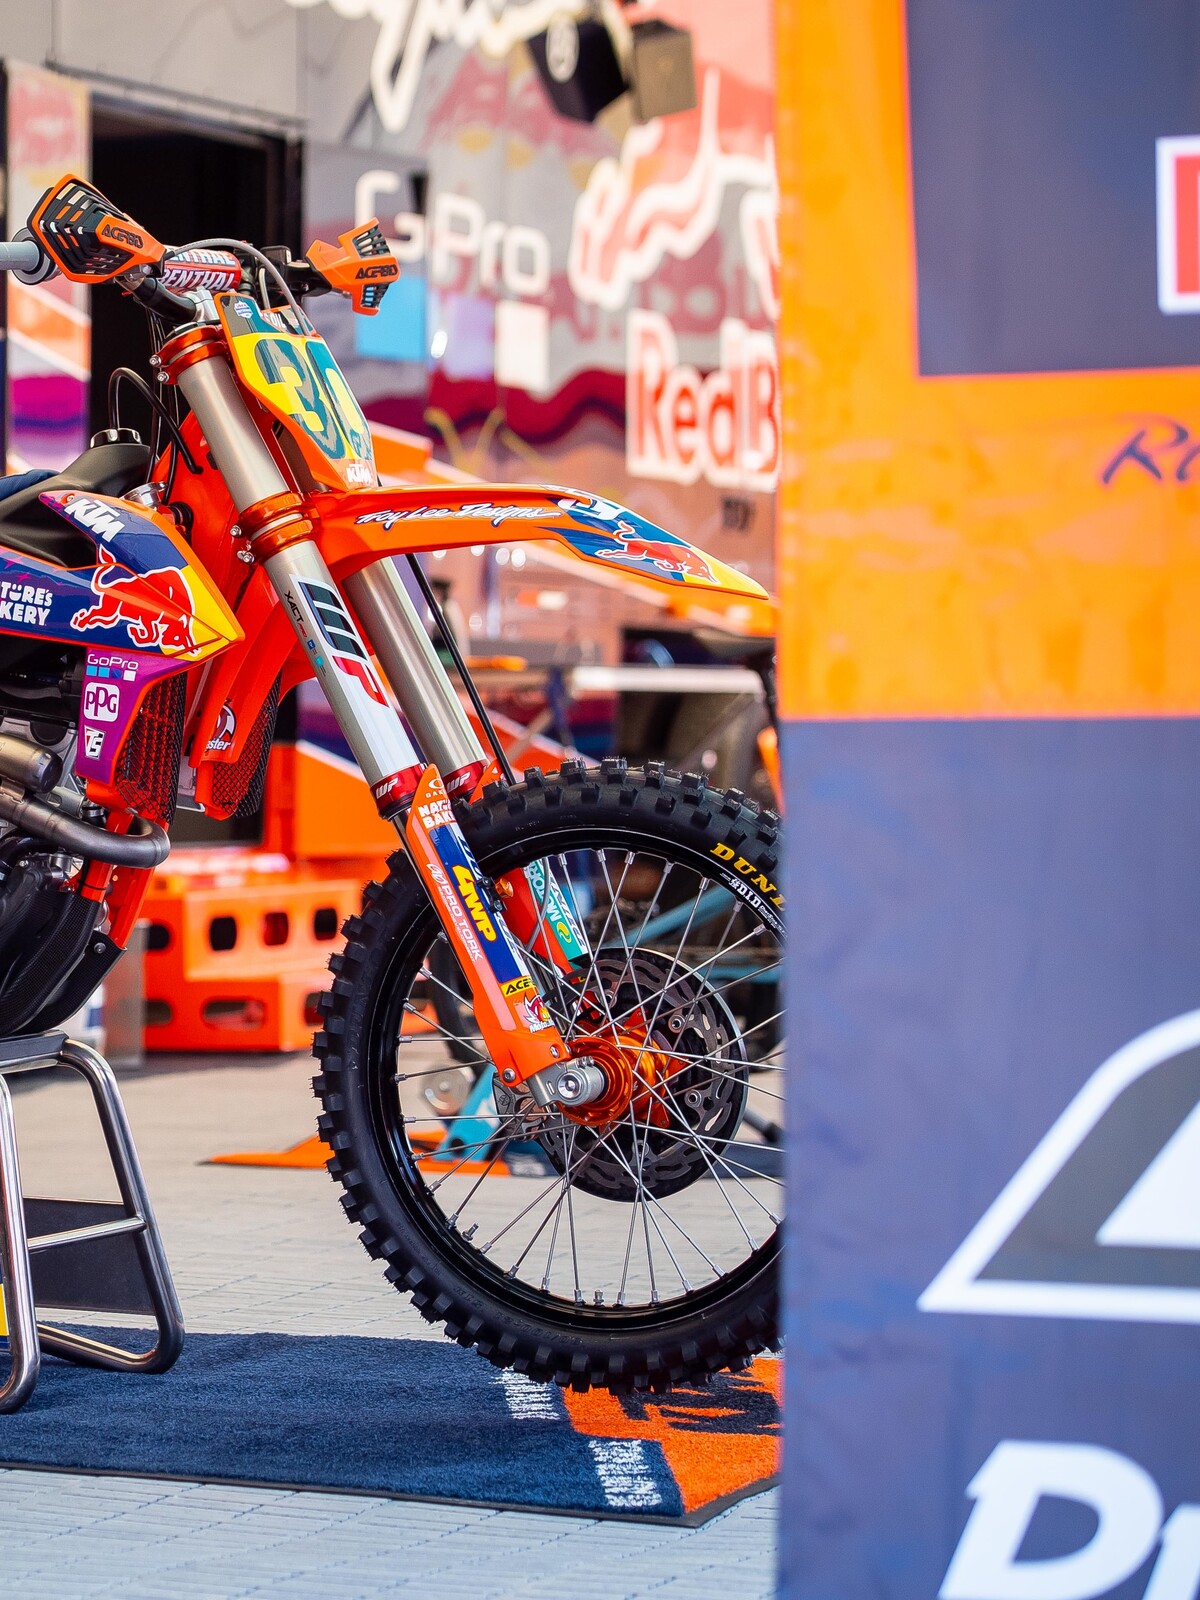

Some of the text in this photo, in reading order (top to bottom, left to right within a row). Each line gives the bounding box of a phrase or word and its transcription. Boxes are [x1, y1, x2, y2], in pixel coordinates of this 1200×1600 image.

[166, 251, 236, 266] ENTHAL
[254, 339, 372, 459] 30
[346, 463, 372, 483] KTM
[64, 498, 126, 542] KTM
[356, 502, 563, 530] Troy Lee Designs
[284, 590, 305, 623] XACT
[87, 654, 139, 670] GoPro
[376, 777, 399, 800] WP
[446, 771, 471, 796] WP
[452, 864, 498, 942] 4WP
[441, 884, 483, 960] PRO TORK
